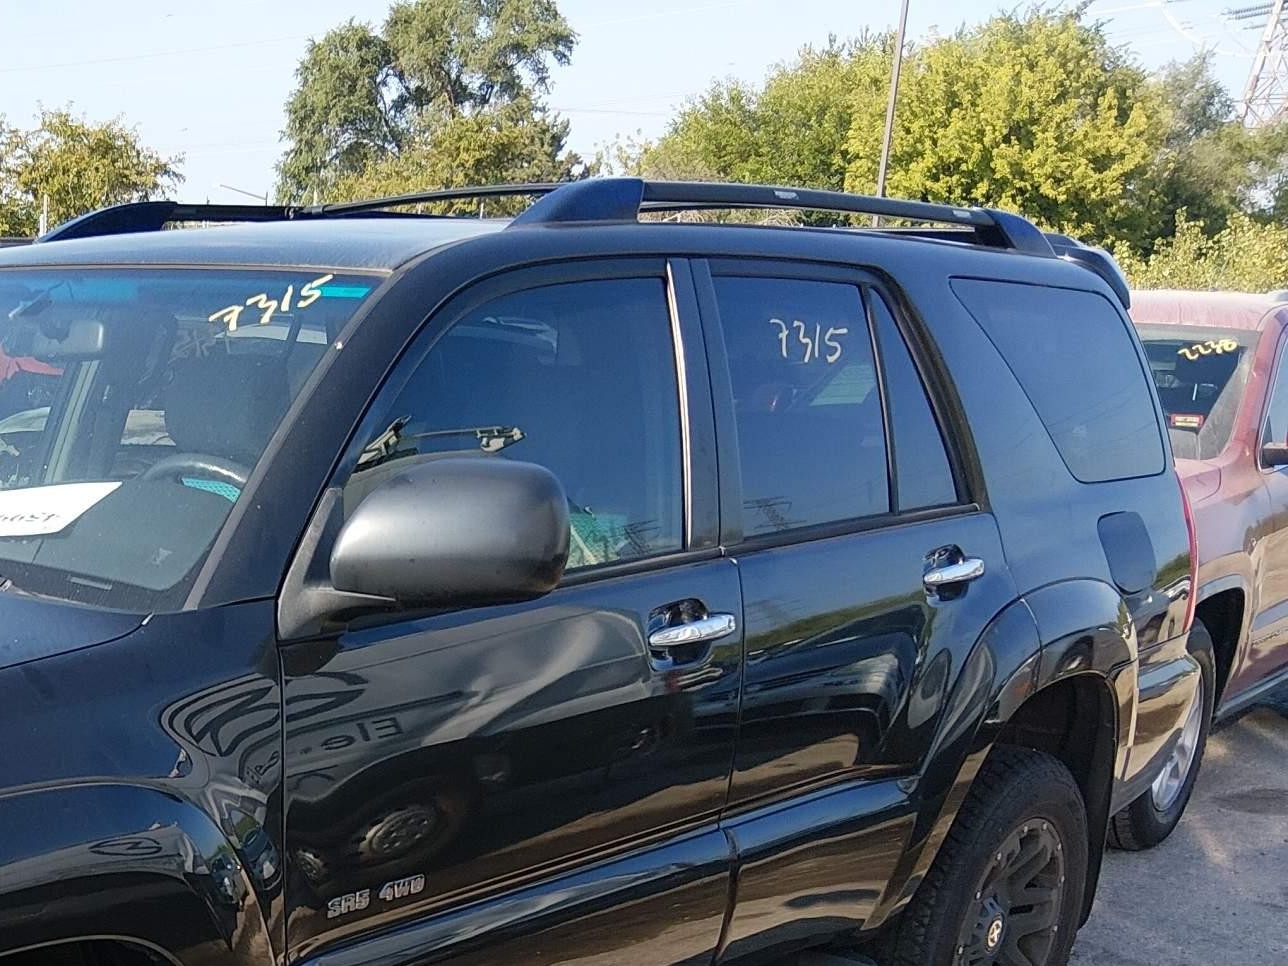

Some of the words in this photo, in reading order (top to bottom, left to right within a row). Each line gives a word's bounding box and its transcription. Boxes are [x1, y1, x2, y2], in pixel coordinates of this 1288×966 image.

[208, 273, 334, 332] 7315
[769, 318, 849, 364] 7315
[326, 888, 371, 918] SR5
[378, 873, 426, 902] 4WD
